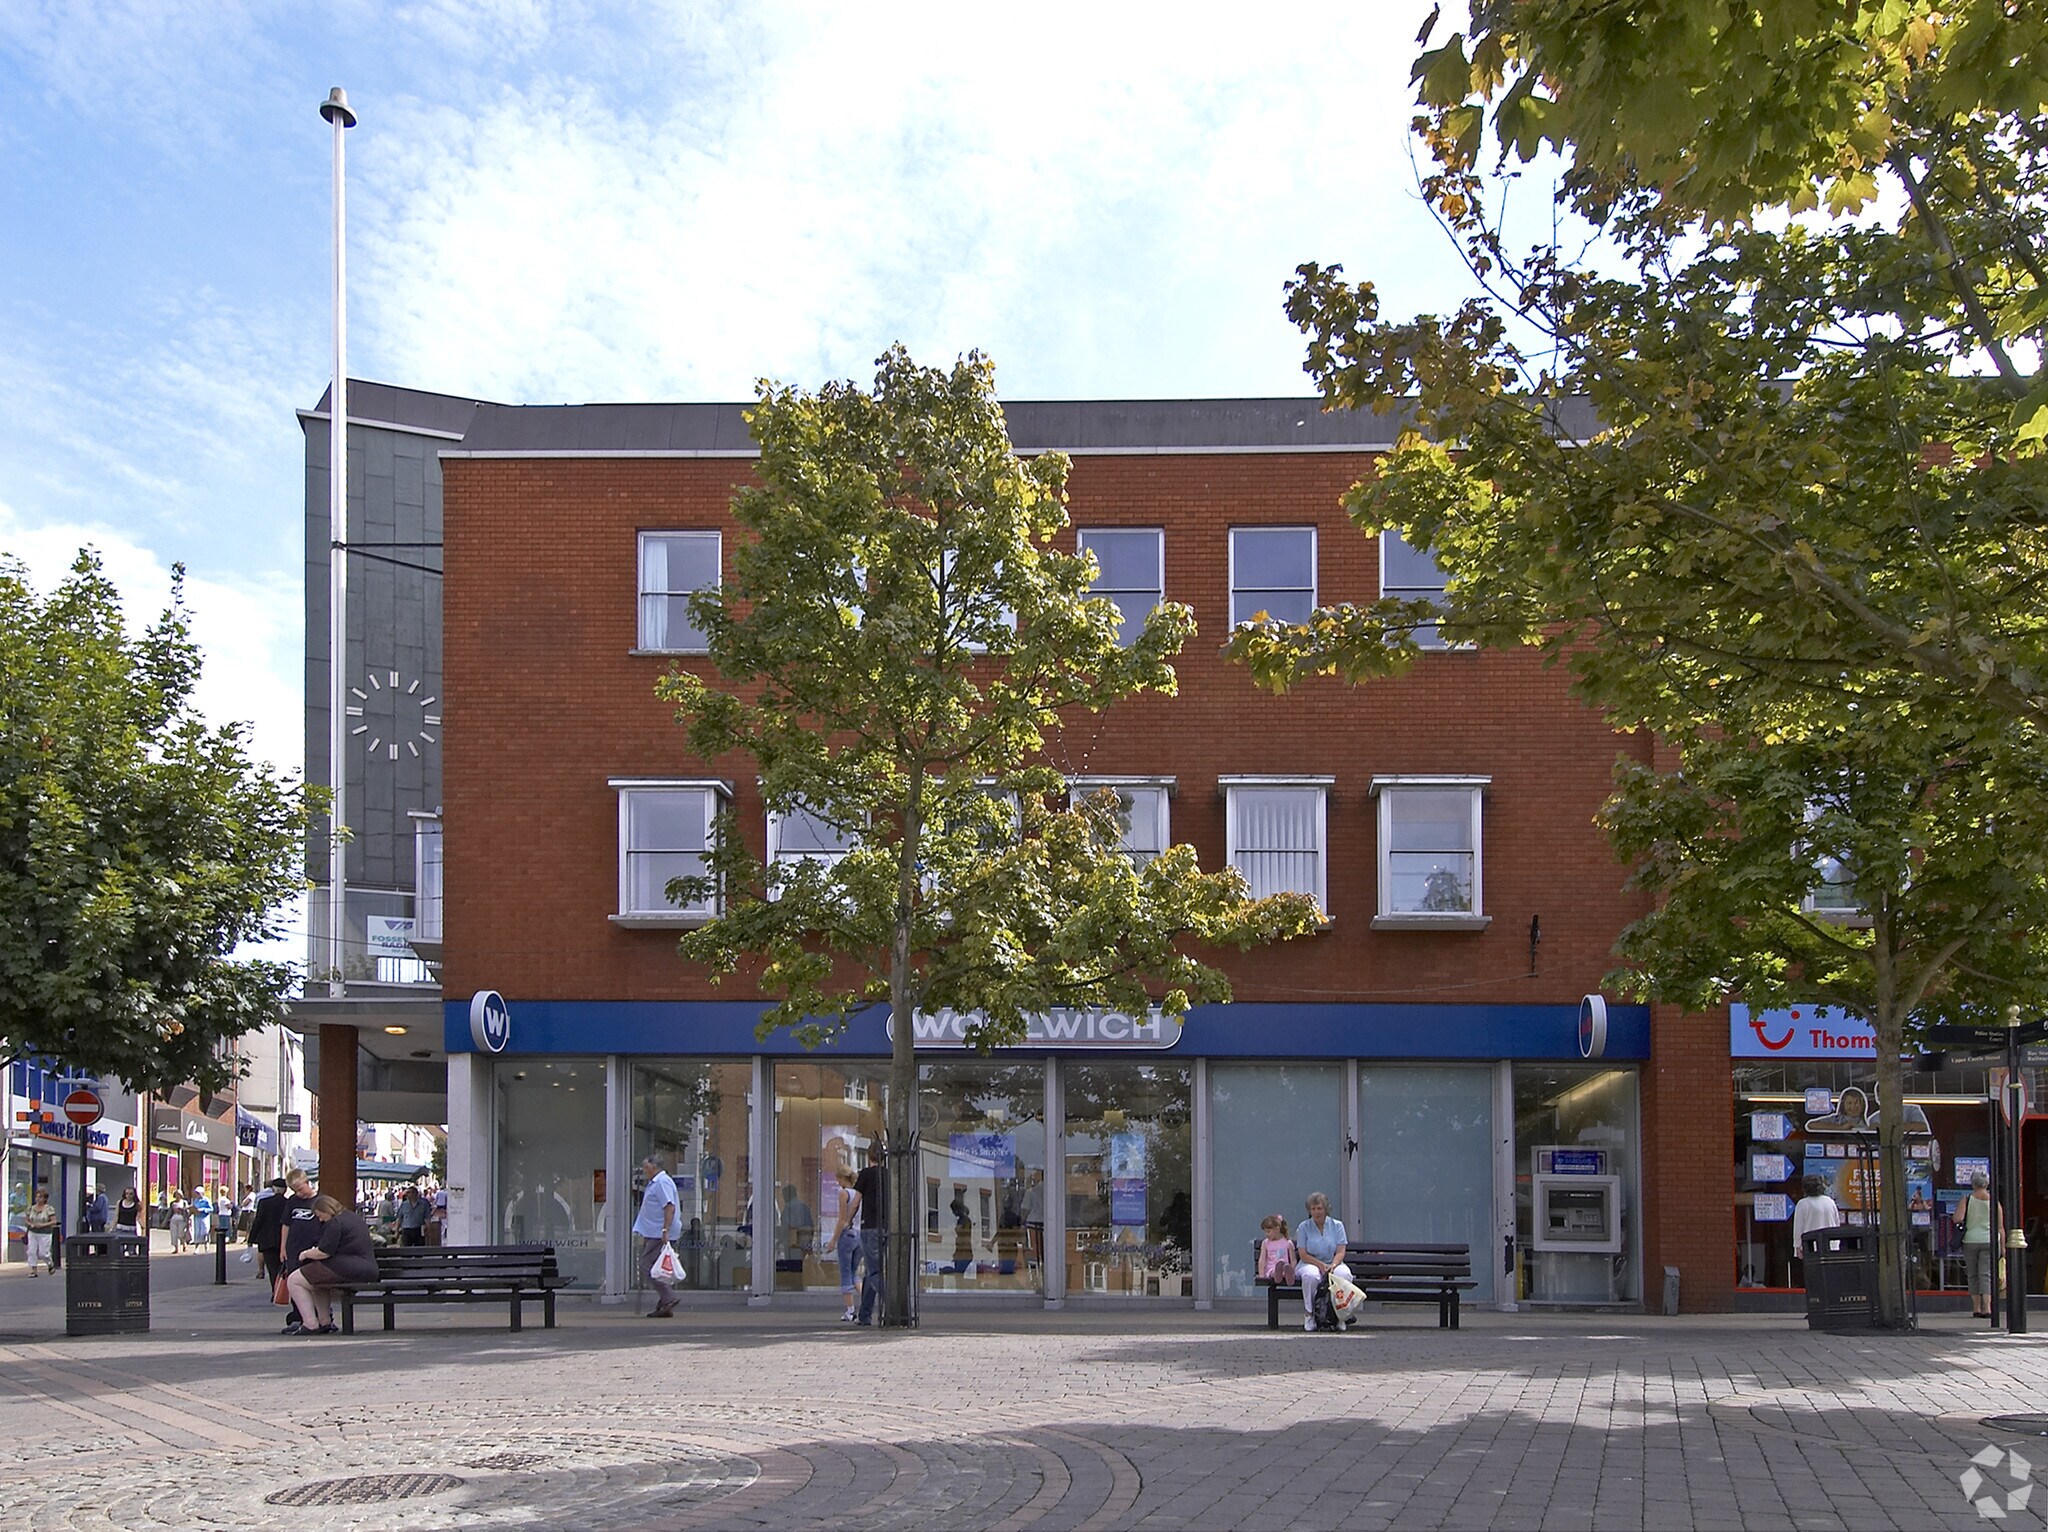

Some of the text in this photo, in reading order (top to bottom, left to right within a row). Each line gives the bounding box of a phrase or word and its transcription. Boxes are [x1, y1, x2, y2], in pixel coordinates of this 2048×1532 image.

[486, 1006, 504, 1037] W
[913, 1013, 1160, 1040] WOLWICH
[185, 1119, 209, 1144] Clarks
